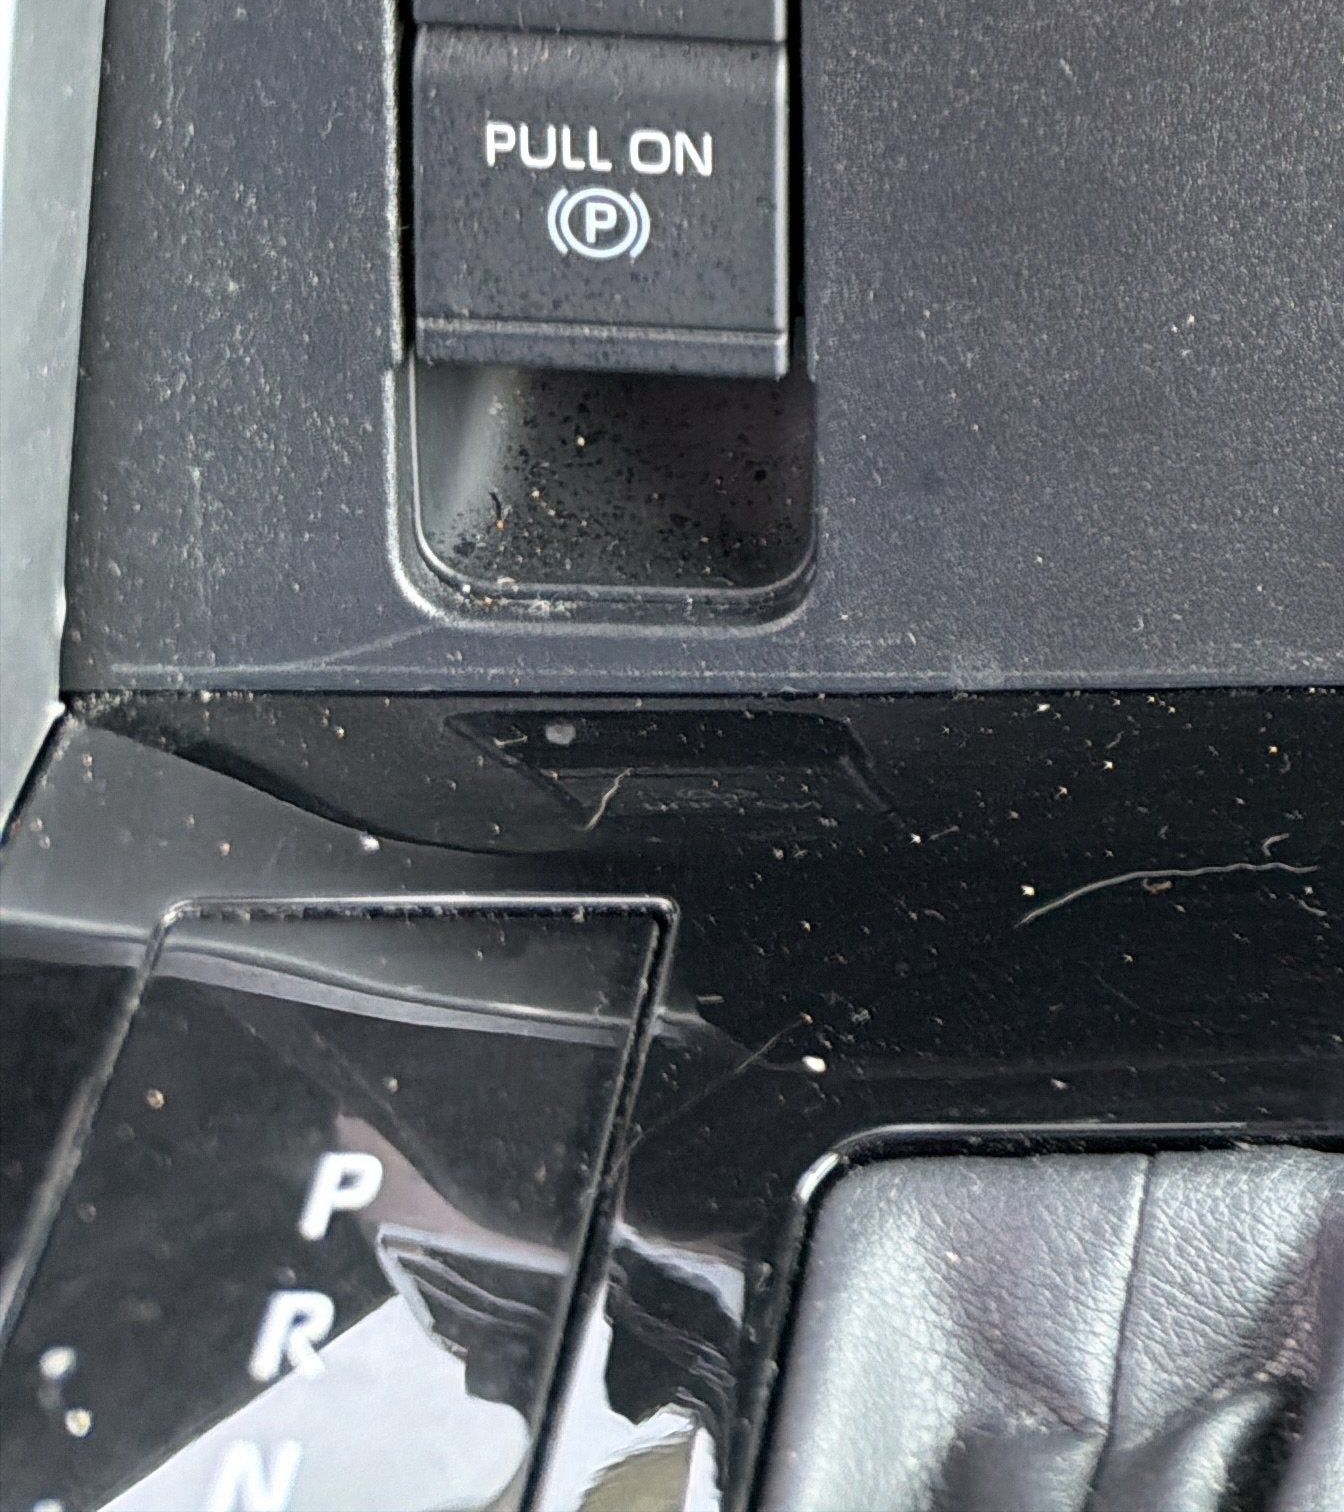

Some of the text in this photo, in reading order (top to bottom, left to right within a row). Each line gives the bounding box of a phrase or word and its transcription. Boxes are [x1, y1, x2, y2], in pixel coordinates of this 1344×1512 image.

[486, 120, 712, 177] PULL ON
[585, 201, 617, 244] P
[300, 1150, 383, 1241] P
[248, 1289, 335, 1382] R
[203, 1438, 302, 1512] N
